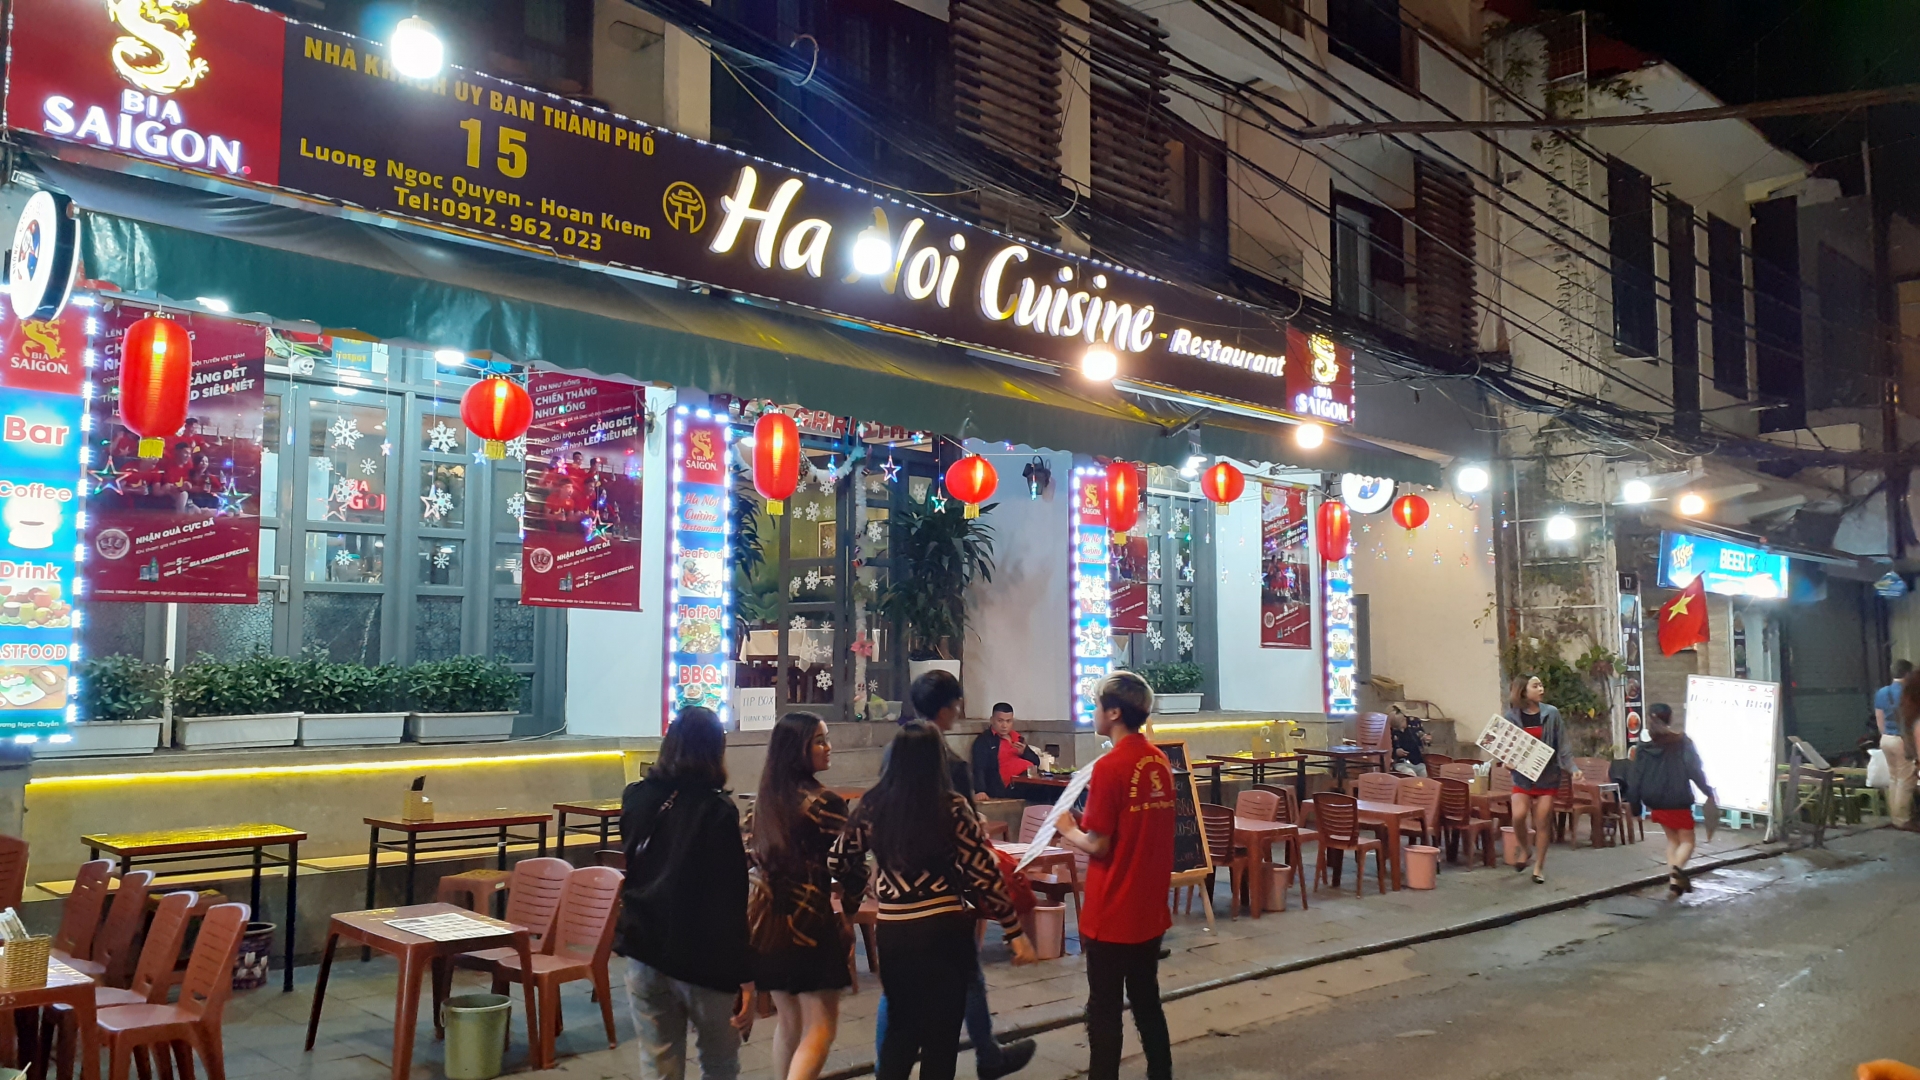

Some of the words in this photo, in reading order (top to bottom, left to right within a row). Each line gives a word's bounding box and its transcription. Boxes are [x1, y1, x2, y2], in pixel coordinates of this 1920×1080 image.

[304, 36, 357, 71] NHÀ
[489, 90, 535, 121] BAN
[542, 105, 611, 143] THÀNH
[614, 126, 655, 156] PHỐ
[121, 88, 182, 125] BIA
[43, 95, 243, 174] SAIGON
[459, 117, 528, 179] 15
[300, 137, 377, 177] Luong
[386, 159, 444, 189] Ngoc
[452, 176, 521, 208] Quyen
[541, 197, 594, 226] Hoan
[709, 165, 832, 279] Ha
[980, 244, 1155, 353] Cuisine
[1169, 328, 1286, 377] Restaurant
[11, 356, 69, 375] SAIGON
[31, 352, 49, 361] BIA
[202, 384, 229, 398] SIÊU
[230, 378, 255, 393] NÉT
[535, 390, 564, 407] CHIẾN
[565, 386, 598, 398] THẮNG
[535, 406, 558, 420] NHƯ
[1295, 393, 1348, 421] SAIGON
[4, 415, 69, 446] Bar
[686, 459, 718, 472] SAIGON
[0, 481, 71, 501] Coffee
[684, 508, 718, 522] Cuisine
[136, 532, 161, 544] NHẬN
[162, 525, 181, 538] QUÀ
[1671, 542, 1694, 568] Tiger
[1720, 548, 1745, 571] BEER
[0, 561, 60, 580] Drink
[677, 604, 722, 619] HotPot
[679, 664, 719, 684] BBQ
[757, 695, 774, 706] BOX
